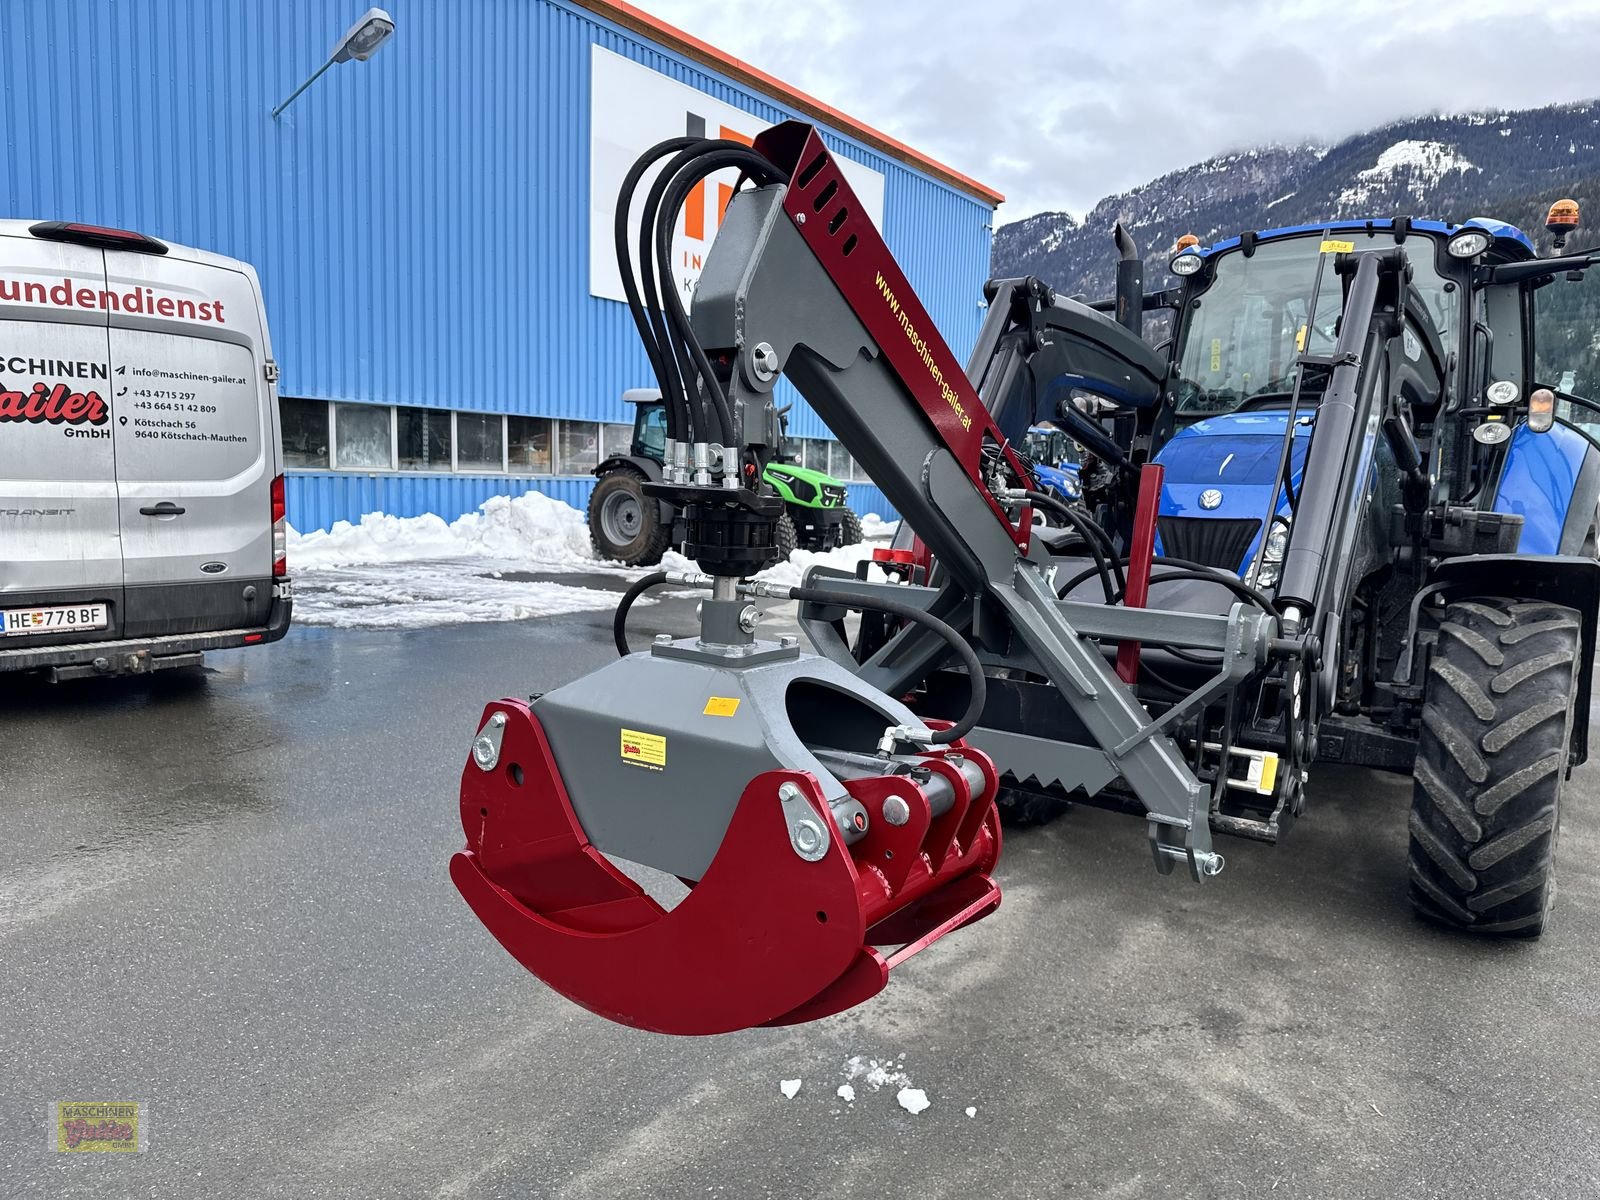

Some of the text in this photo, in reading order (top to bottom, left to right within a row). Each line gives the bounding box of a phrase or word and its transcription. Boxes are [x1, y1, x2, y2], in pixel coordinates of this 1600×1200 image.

[0, 279, 225, 323] undendienst
[875, 271, 971, 432] www.maschinen-gailer.at
[132, 367, 246, 385] info@maschinen-gailer.at
[134, 389, 196, 400] +43 4715 297
[0, 382, 109, 426] ailer
[134, 401, 217, 413] +43 664 51 42 809
[134, 418, 196, 429] Kötschach 56
[64, 427, 111, 439] GmbH
[135, 430, 247, 443] 9640 Kötschach-Mauthen
[9, 608, 100, 629] HE 778 BF
